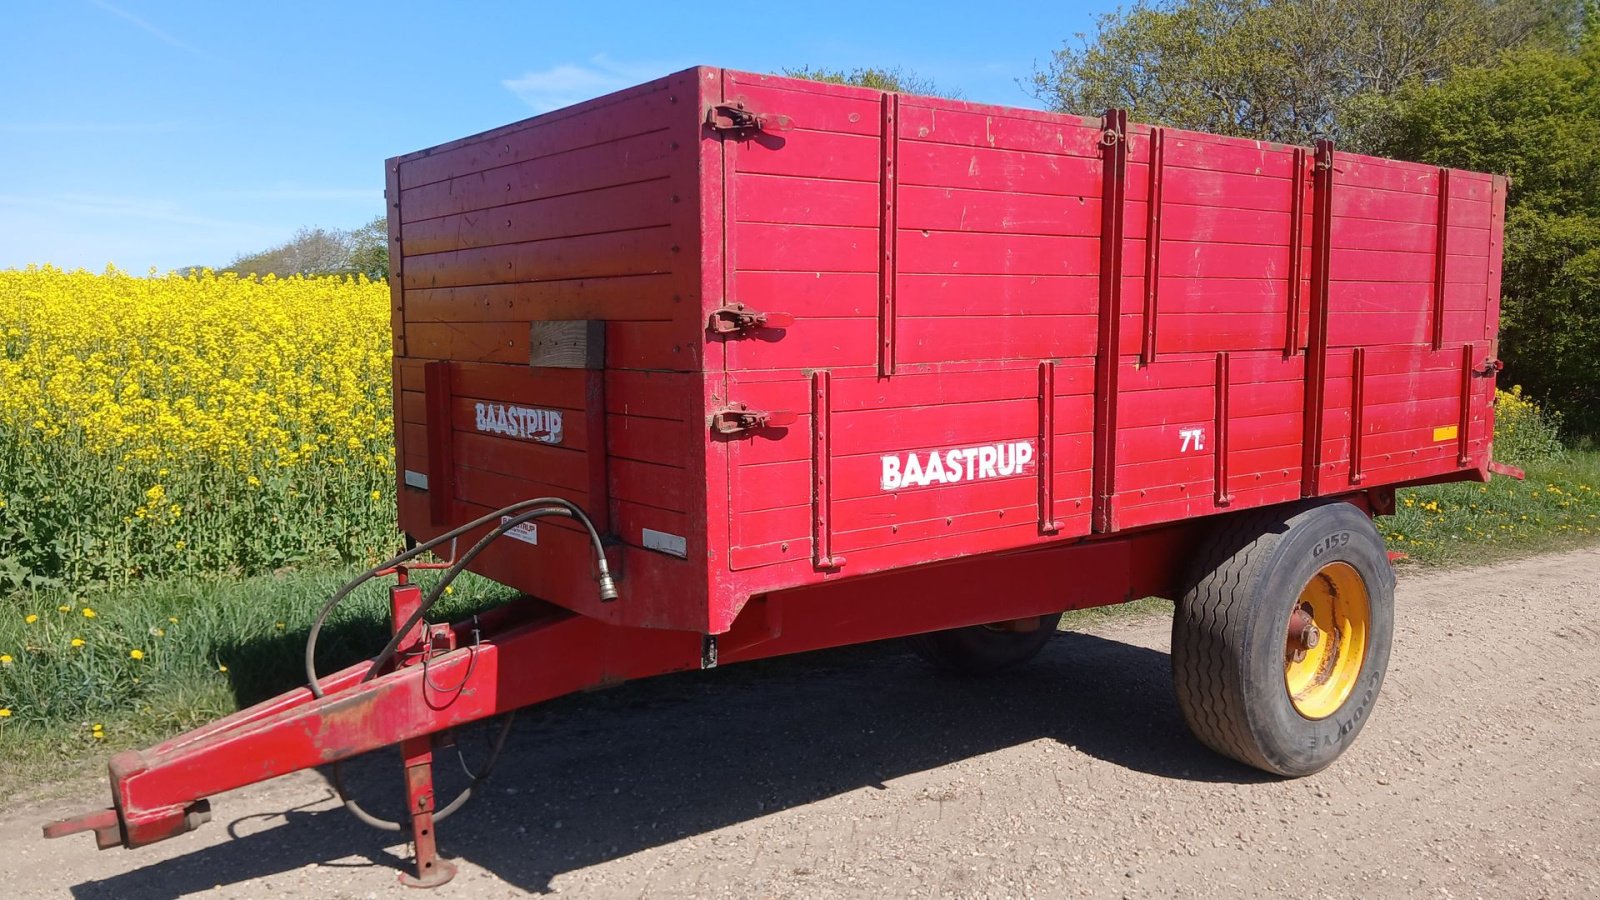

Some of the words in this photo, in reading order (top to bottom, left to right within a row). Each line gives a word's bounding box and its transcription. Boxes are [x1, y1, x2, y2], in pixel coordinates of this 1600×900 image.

[475, 402, 562, 442] BAASTRUP
[882, 442, 1033, 490] BAASTRUP
[503, 517, 536, 532] BTRUP
